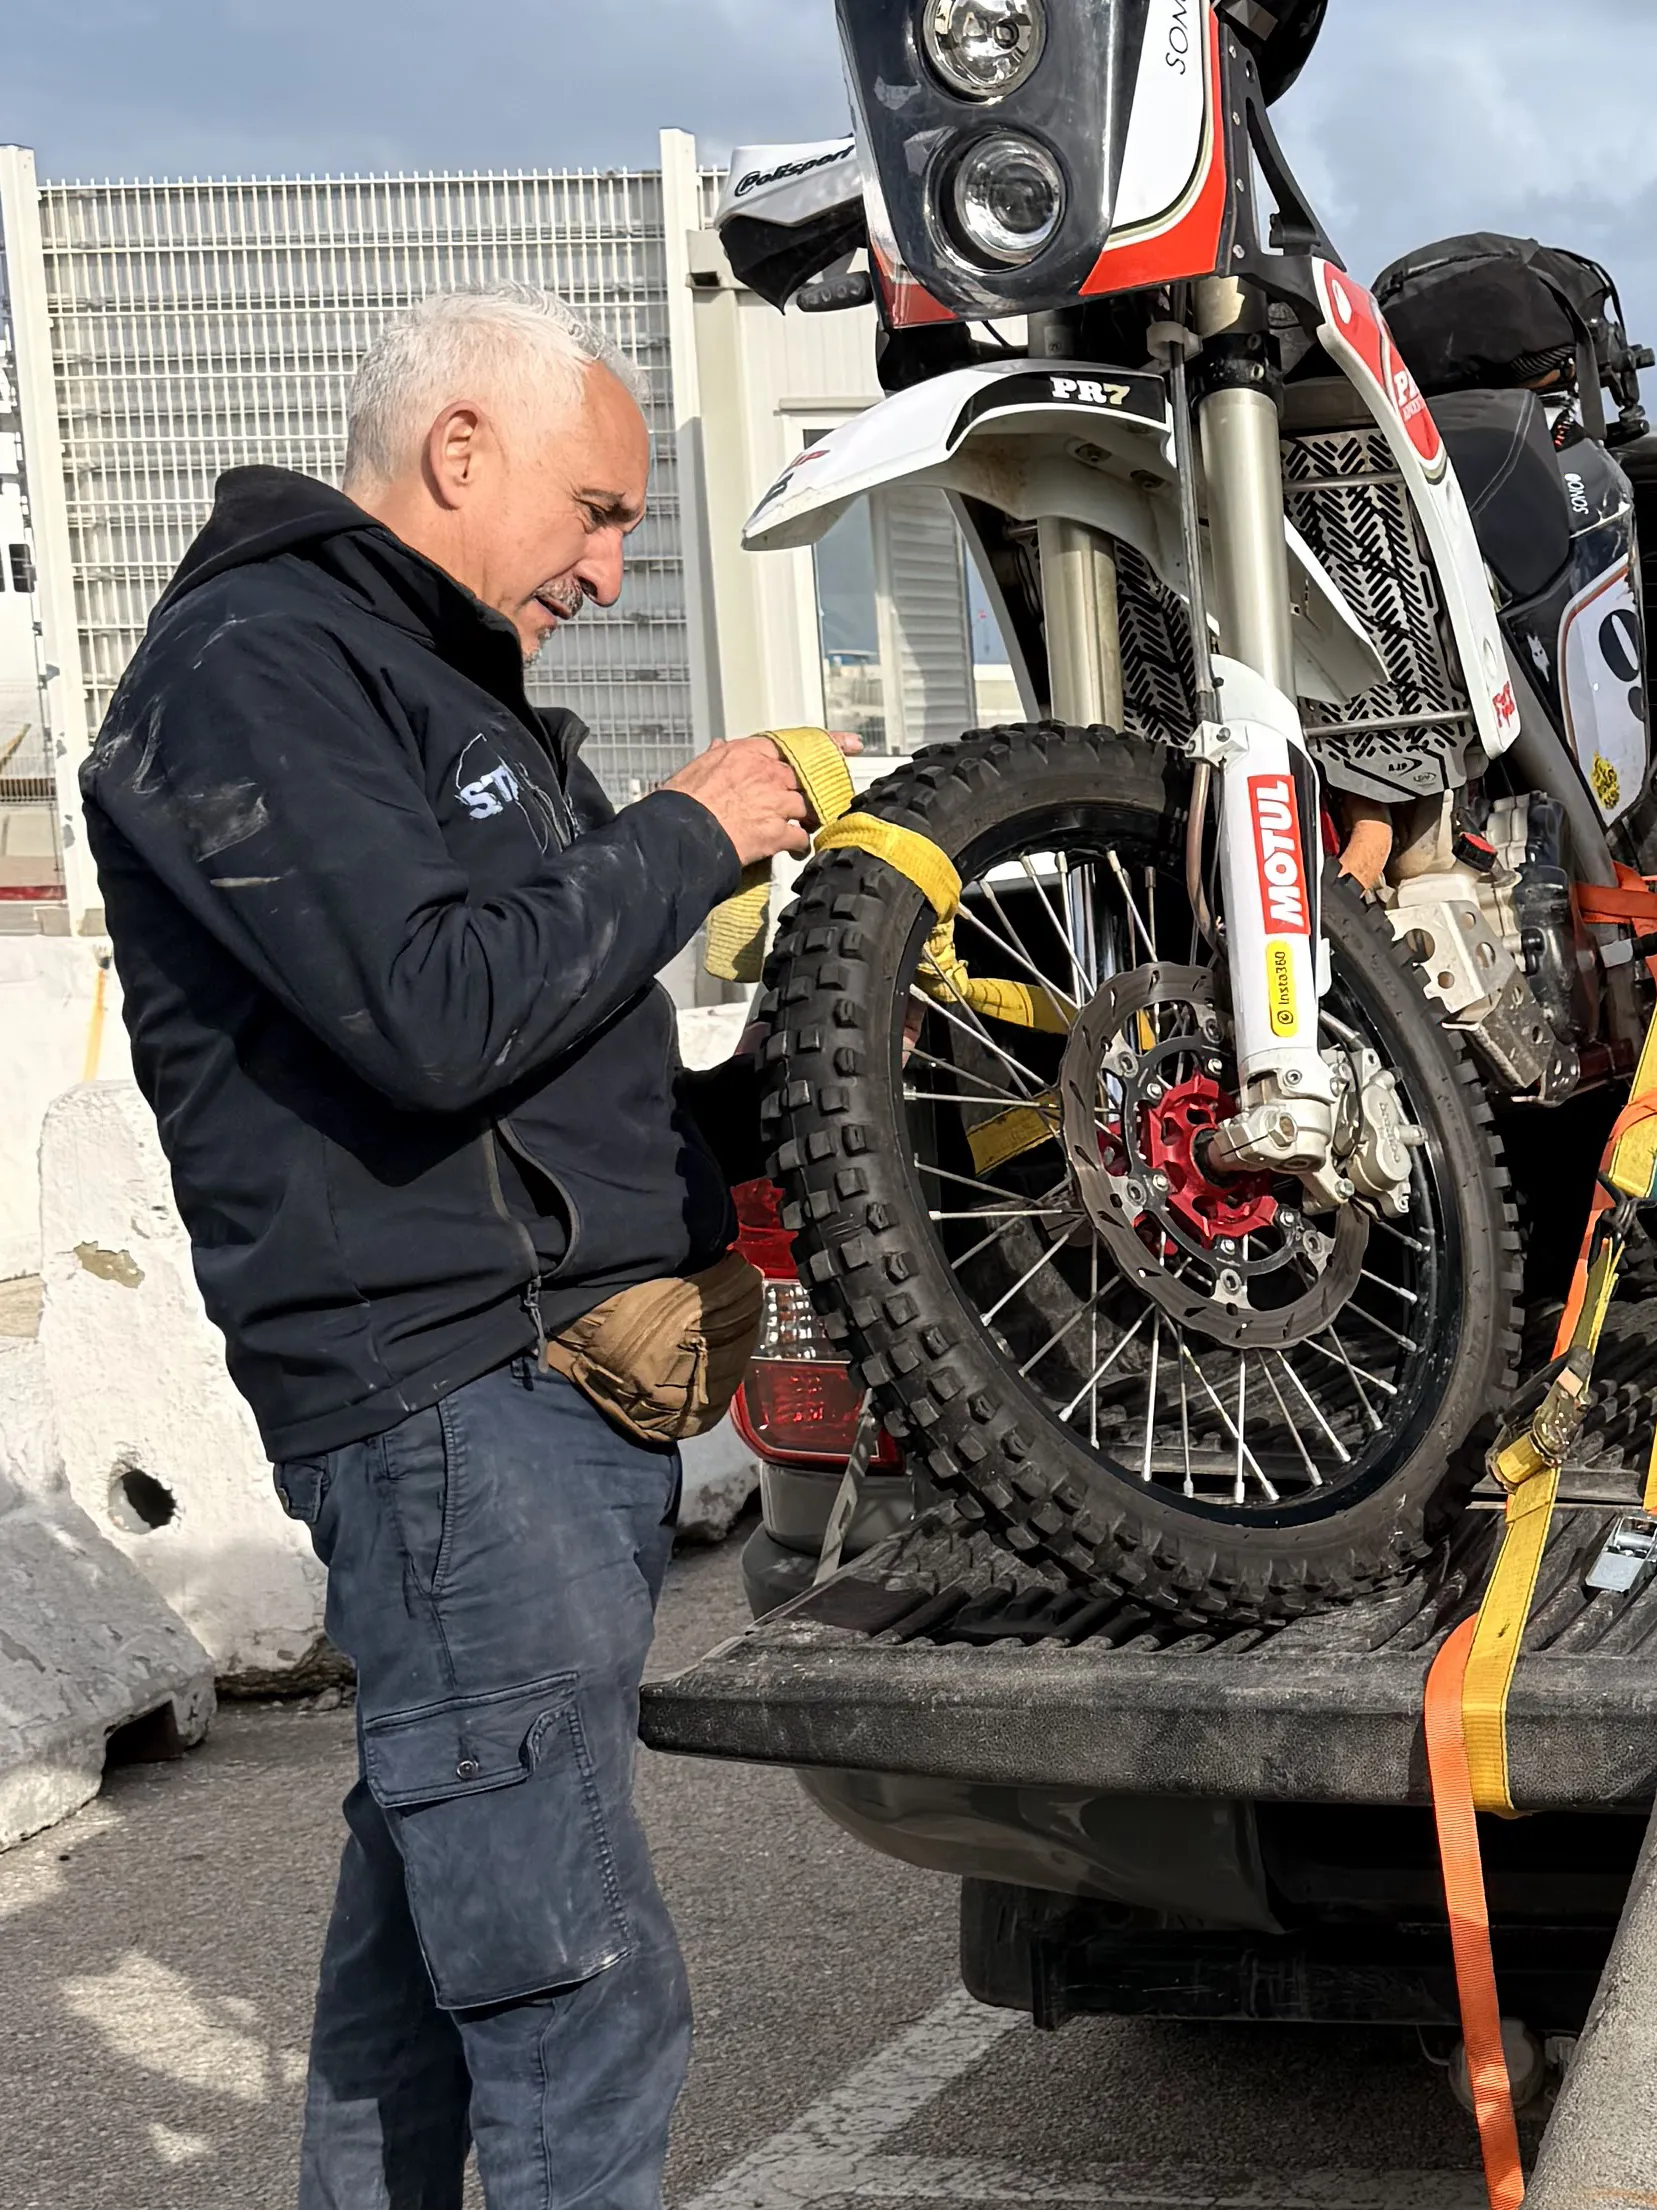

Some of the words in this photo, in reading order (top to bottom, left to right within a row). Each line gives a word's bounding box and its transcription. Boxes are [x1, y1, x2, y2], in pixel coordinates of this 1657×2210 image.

[1165, 0, 1189, 75] SON
[1049, 376, 1131, 405] PR7
[1256, 780, 1304, 927] MOTUL
[1274, 951, 1290, 1005] Insta360
